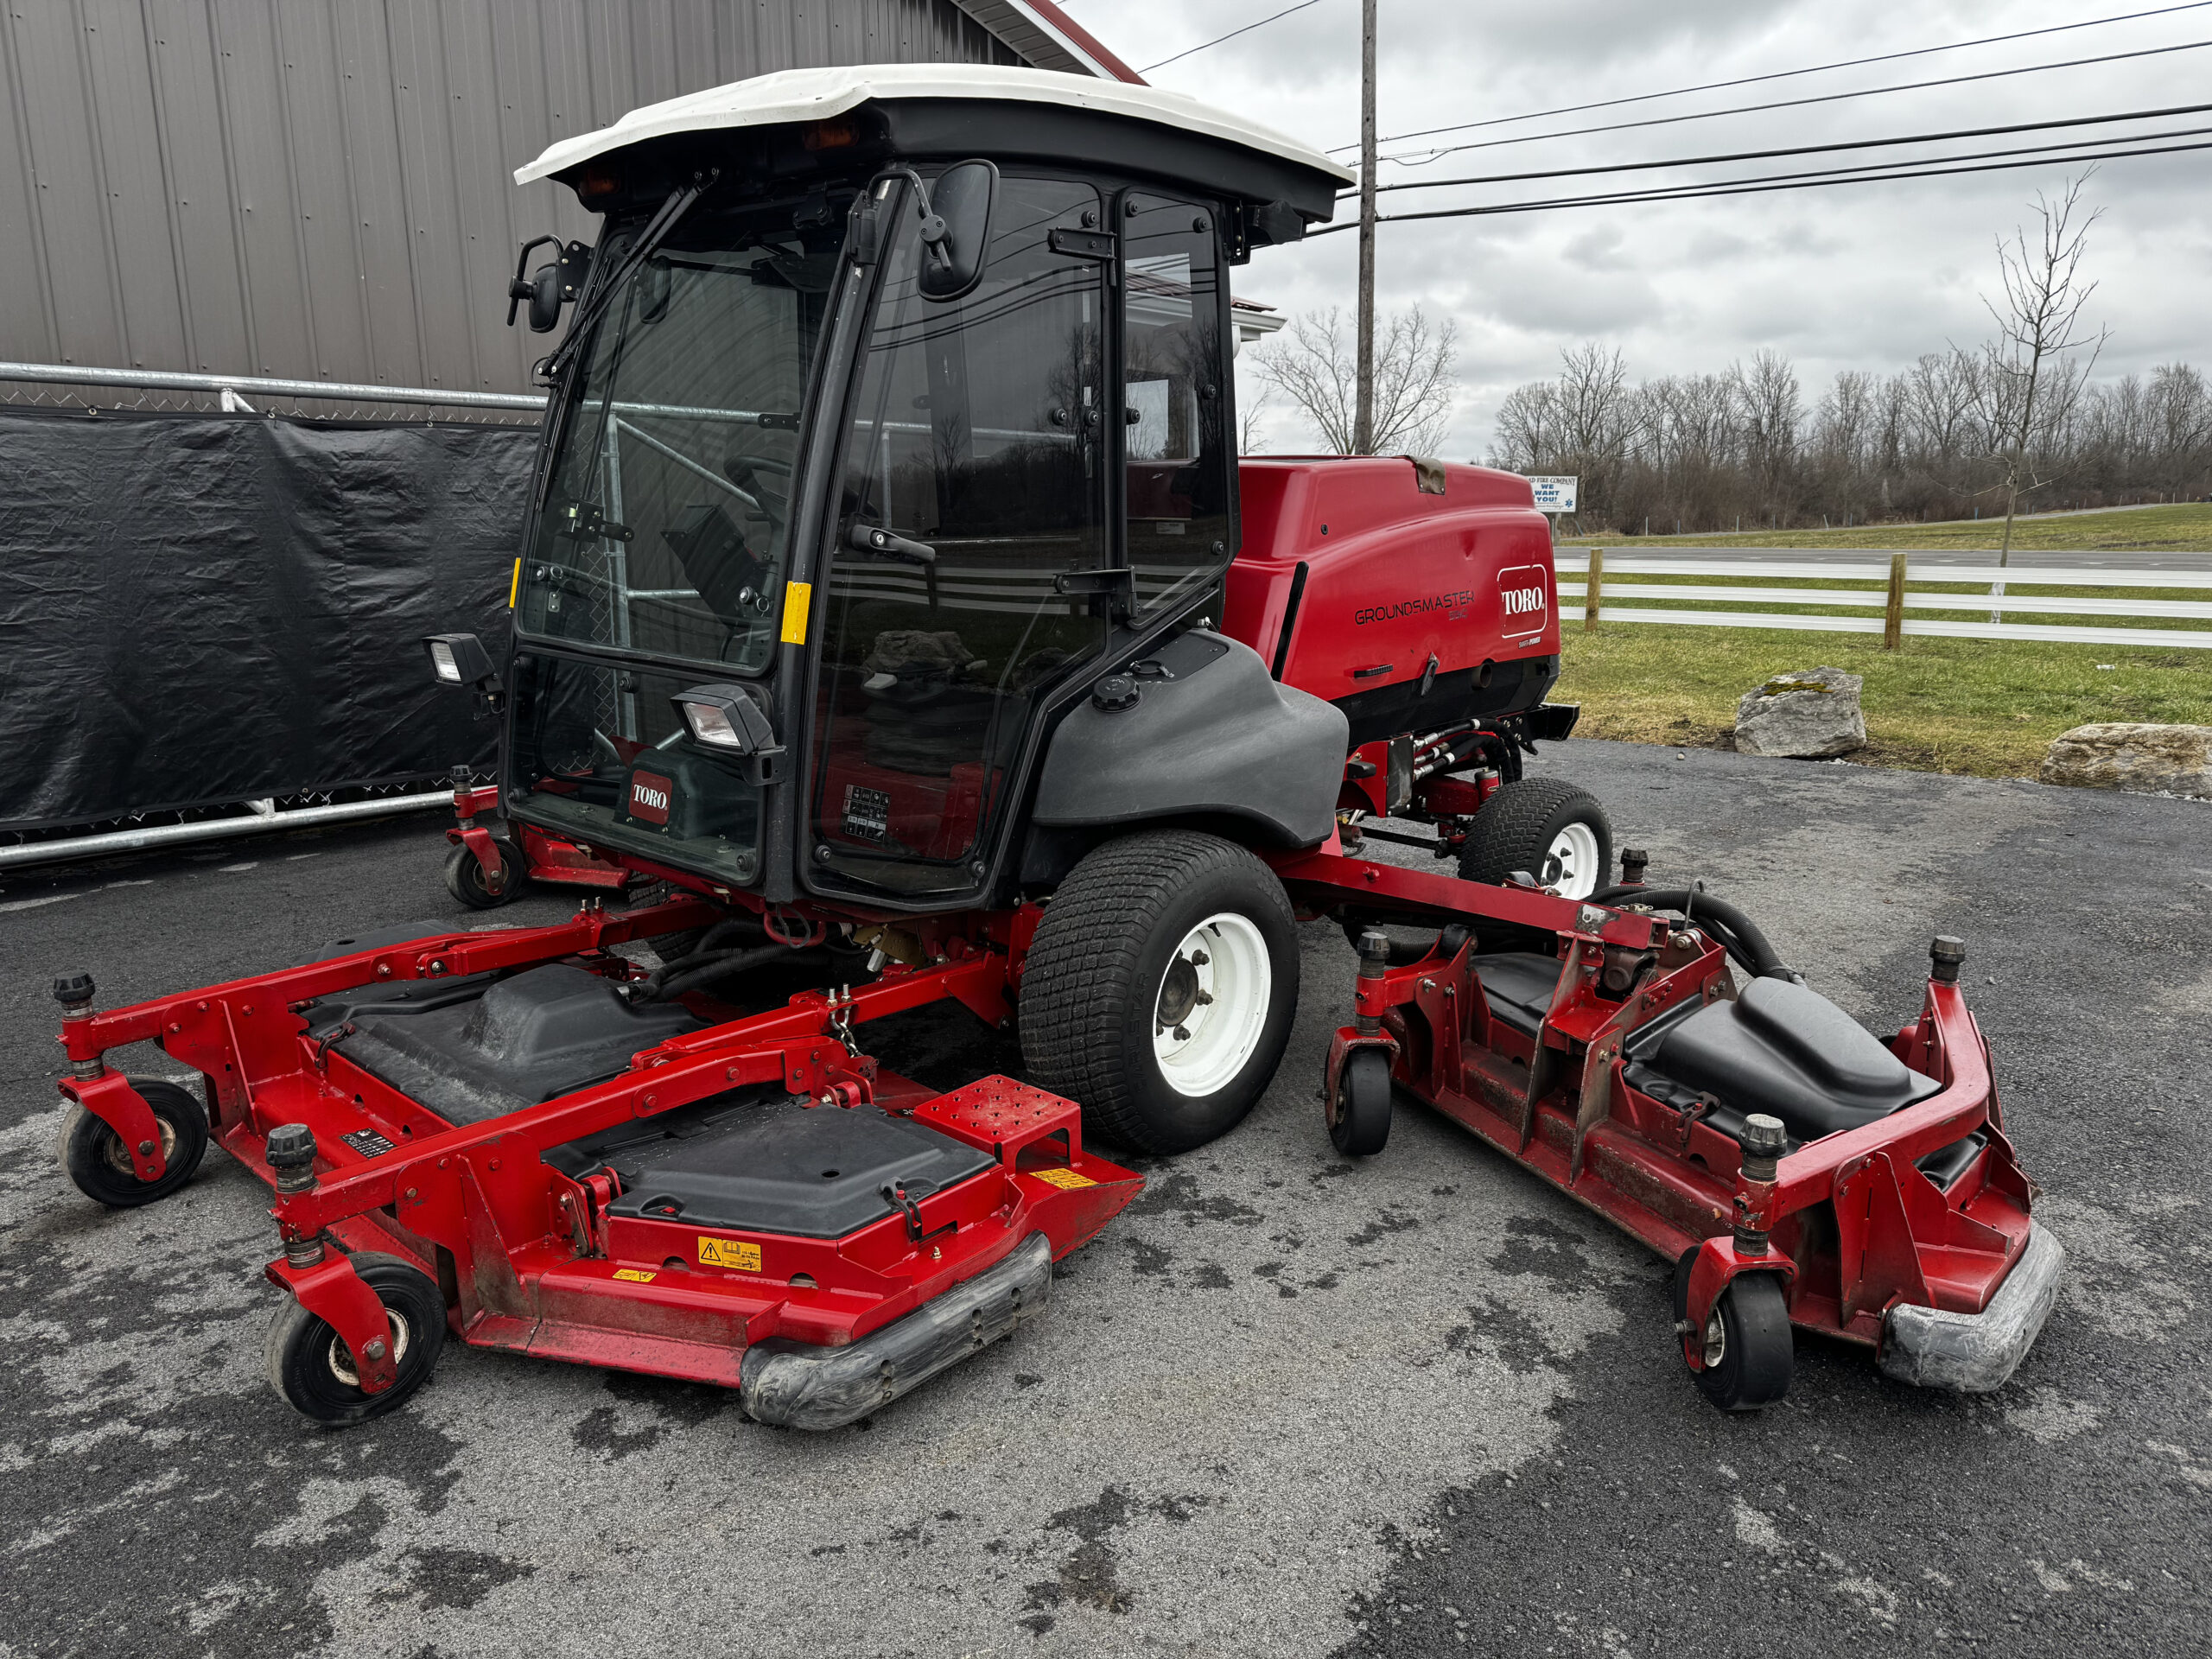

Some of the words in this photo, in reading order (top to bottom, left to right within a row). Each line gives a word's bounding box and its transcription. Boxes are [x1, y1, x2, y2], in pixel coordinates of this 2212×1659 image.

[1354, 590, 1475, 626] GROUNDSMASTER
[1502, 586, 1543, 615] TORO
[633, 784, 667, 810] TORO
